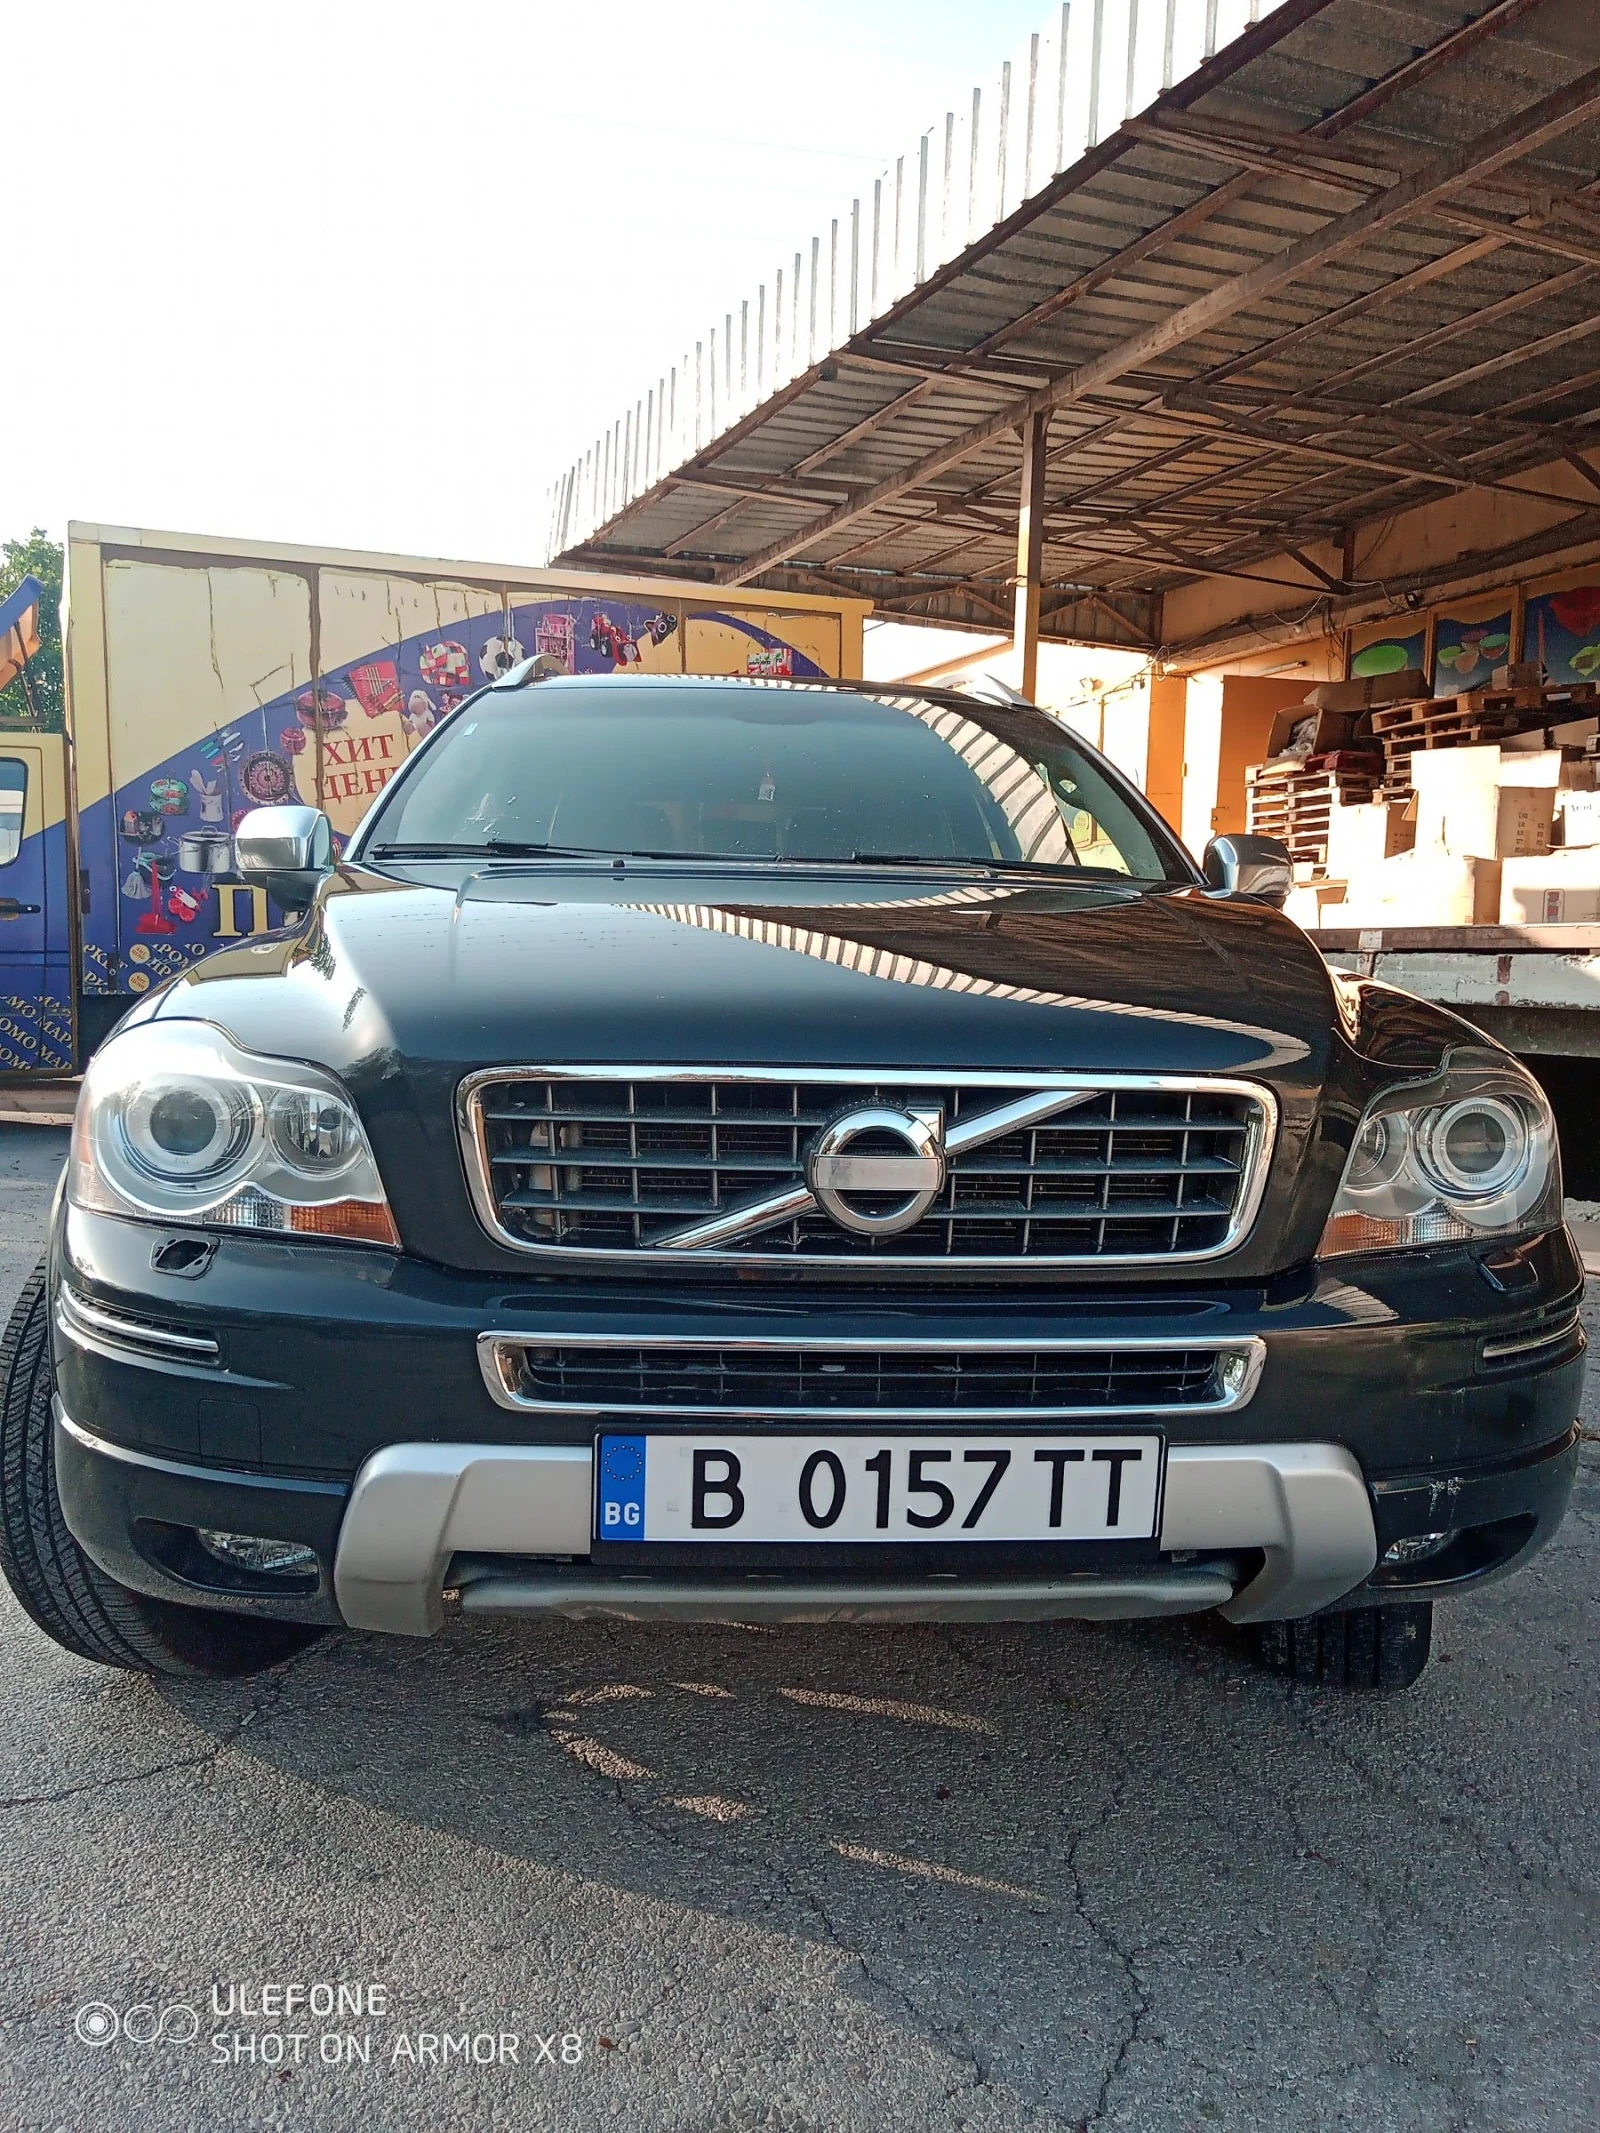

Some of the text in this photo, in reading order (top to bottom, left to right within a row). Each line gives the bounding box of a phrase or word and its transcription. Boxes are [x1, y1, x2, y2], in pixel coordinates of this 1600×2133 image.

[323, 734, 394, 766] ХИТ
[691, 1449, 1143, 1529] B 0157 TT
[604, 1502, 640, 1525] BG
